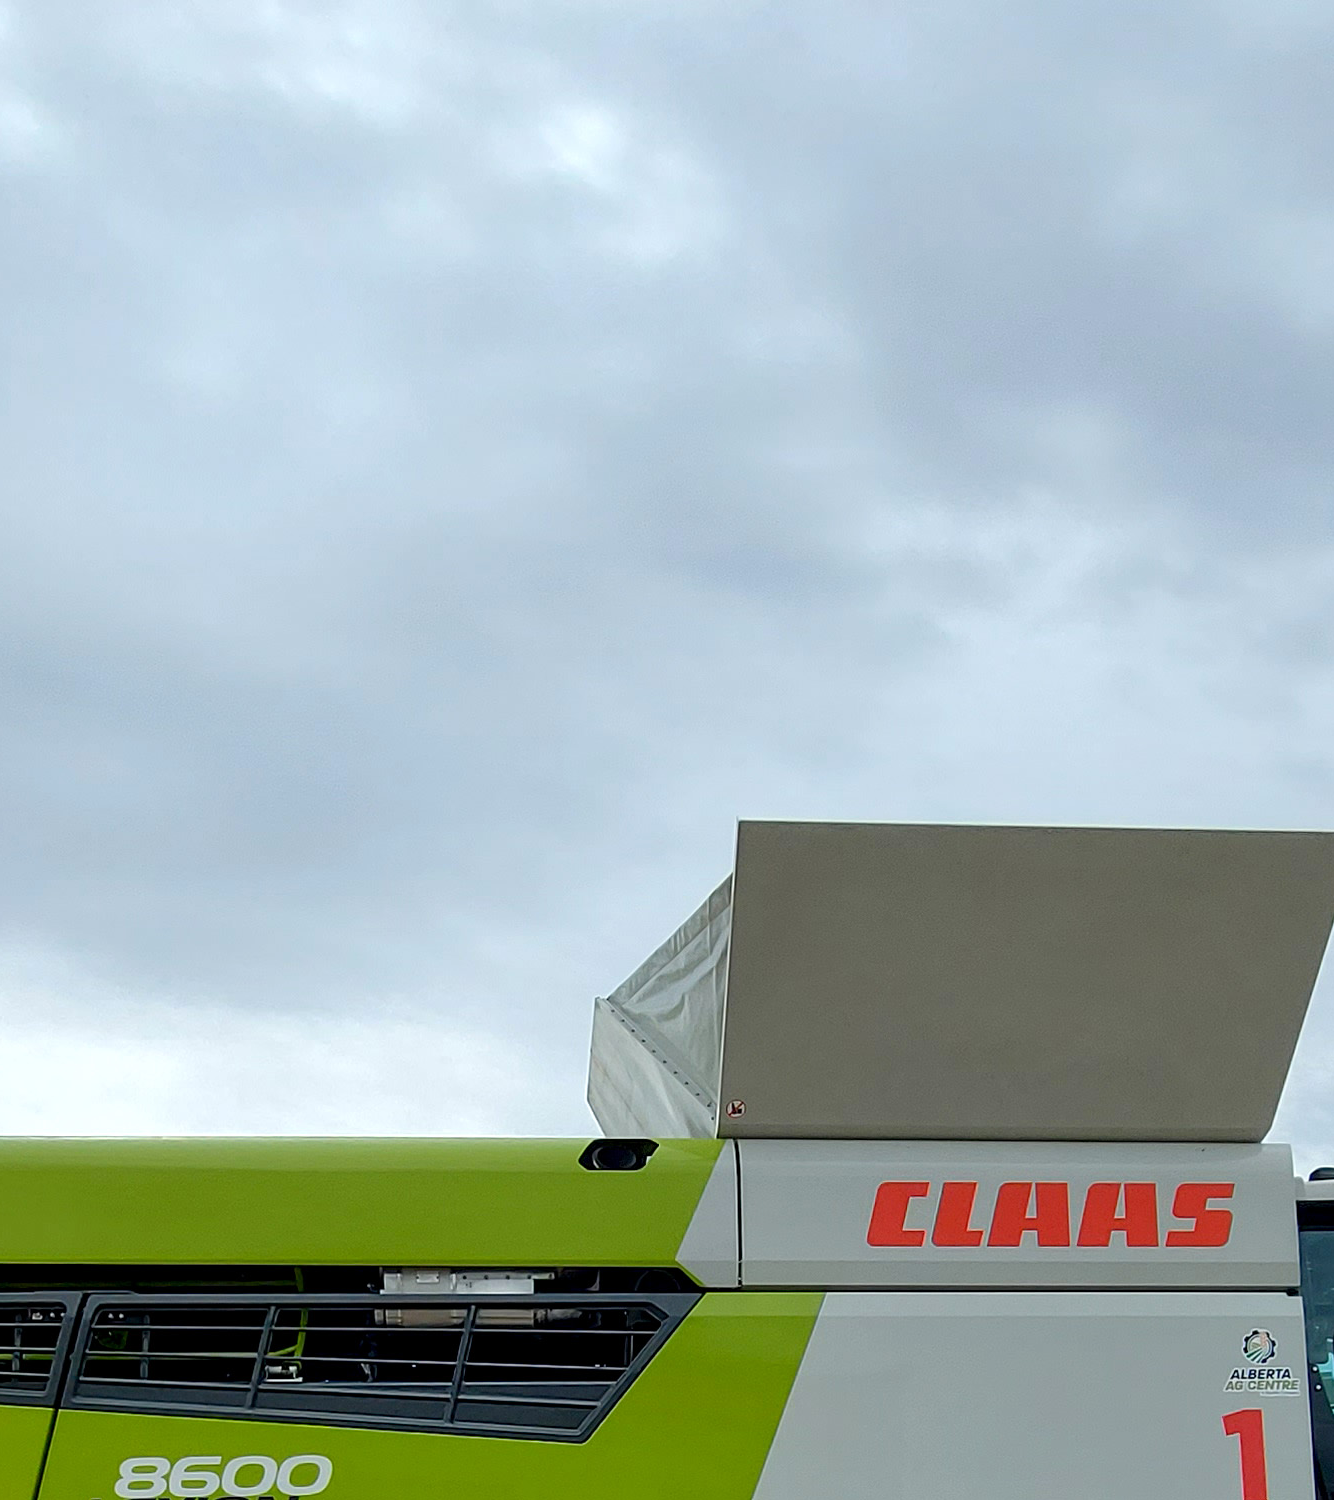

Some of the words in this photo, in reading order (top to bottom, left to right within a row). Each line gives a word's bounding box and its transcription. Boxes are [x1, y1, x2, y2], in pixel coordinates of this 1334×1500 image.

[867, 1181, 1235, 1248] CLAAS
[1225, 1380, 1243, 1391] AG
[1247, 1380, 1299, 1390] CENTRE
[1230, 1368, 1291, 1380] ALBERTA
[114, 1454, 333, 1498] 8600
